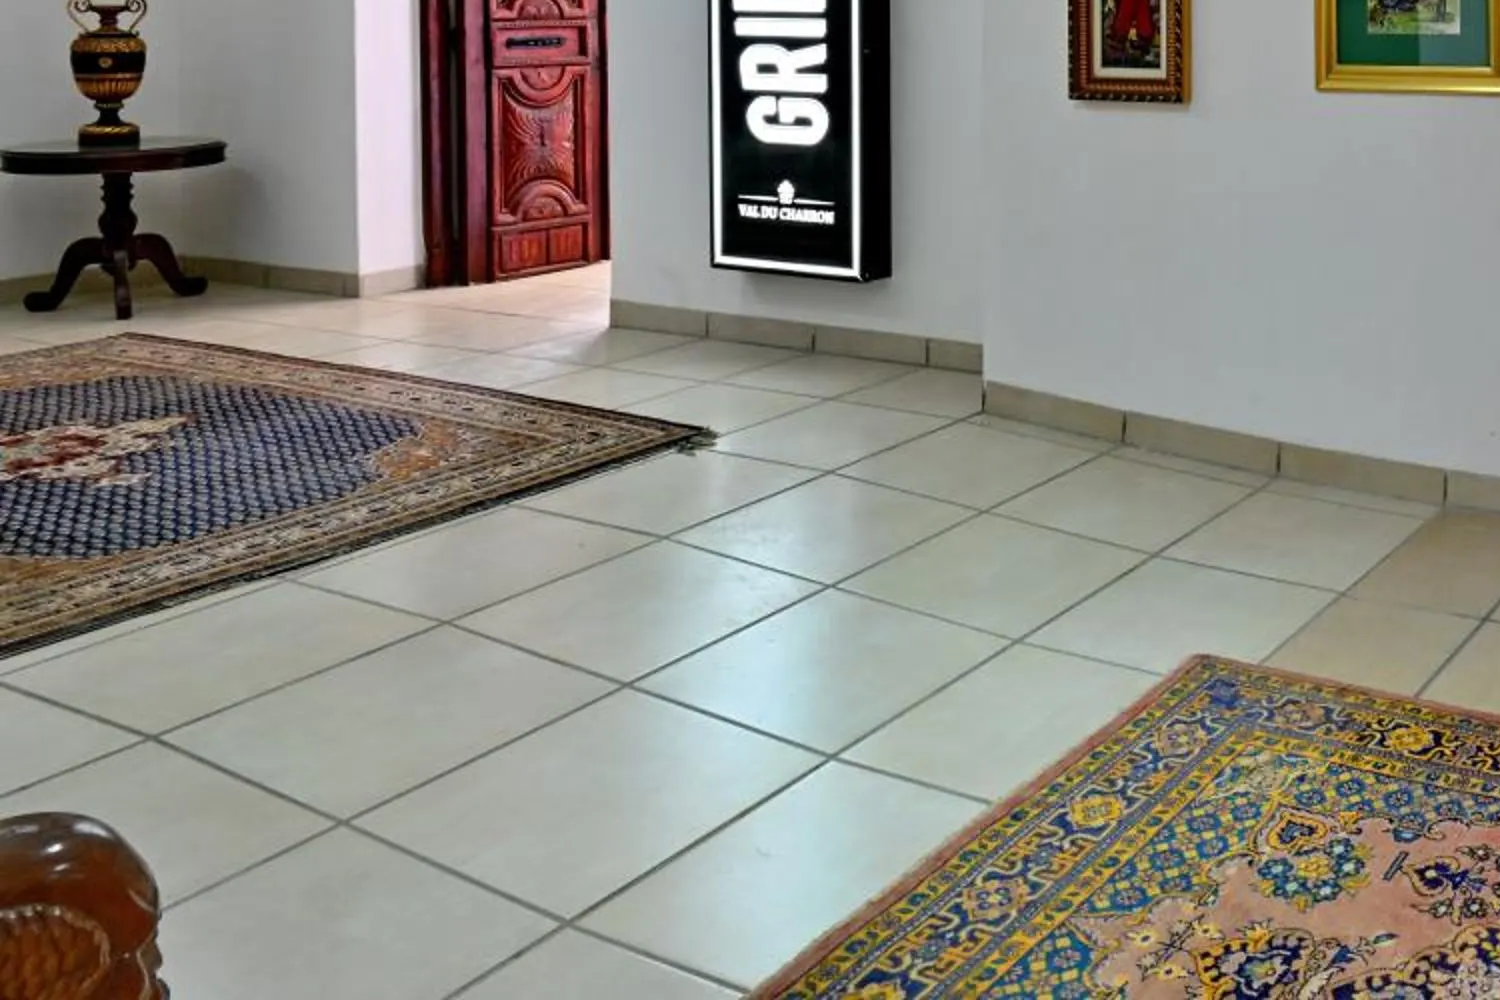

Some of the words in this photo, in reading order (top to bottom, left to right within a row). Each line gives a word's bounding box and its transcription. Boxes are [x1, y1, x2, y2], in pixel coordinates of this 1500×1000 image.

[738, 203, 761, 218] VAL
[761, 205, 779, 219] DU
[780, 207, 835, 225] CHARRON
